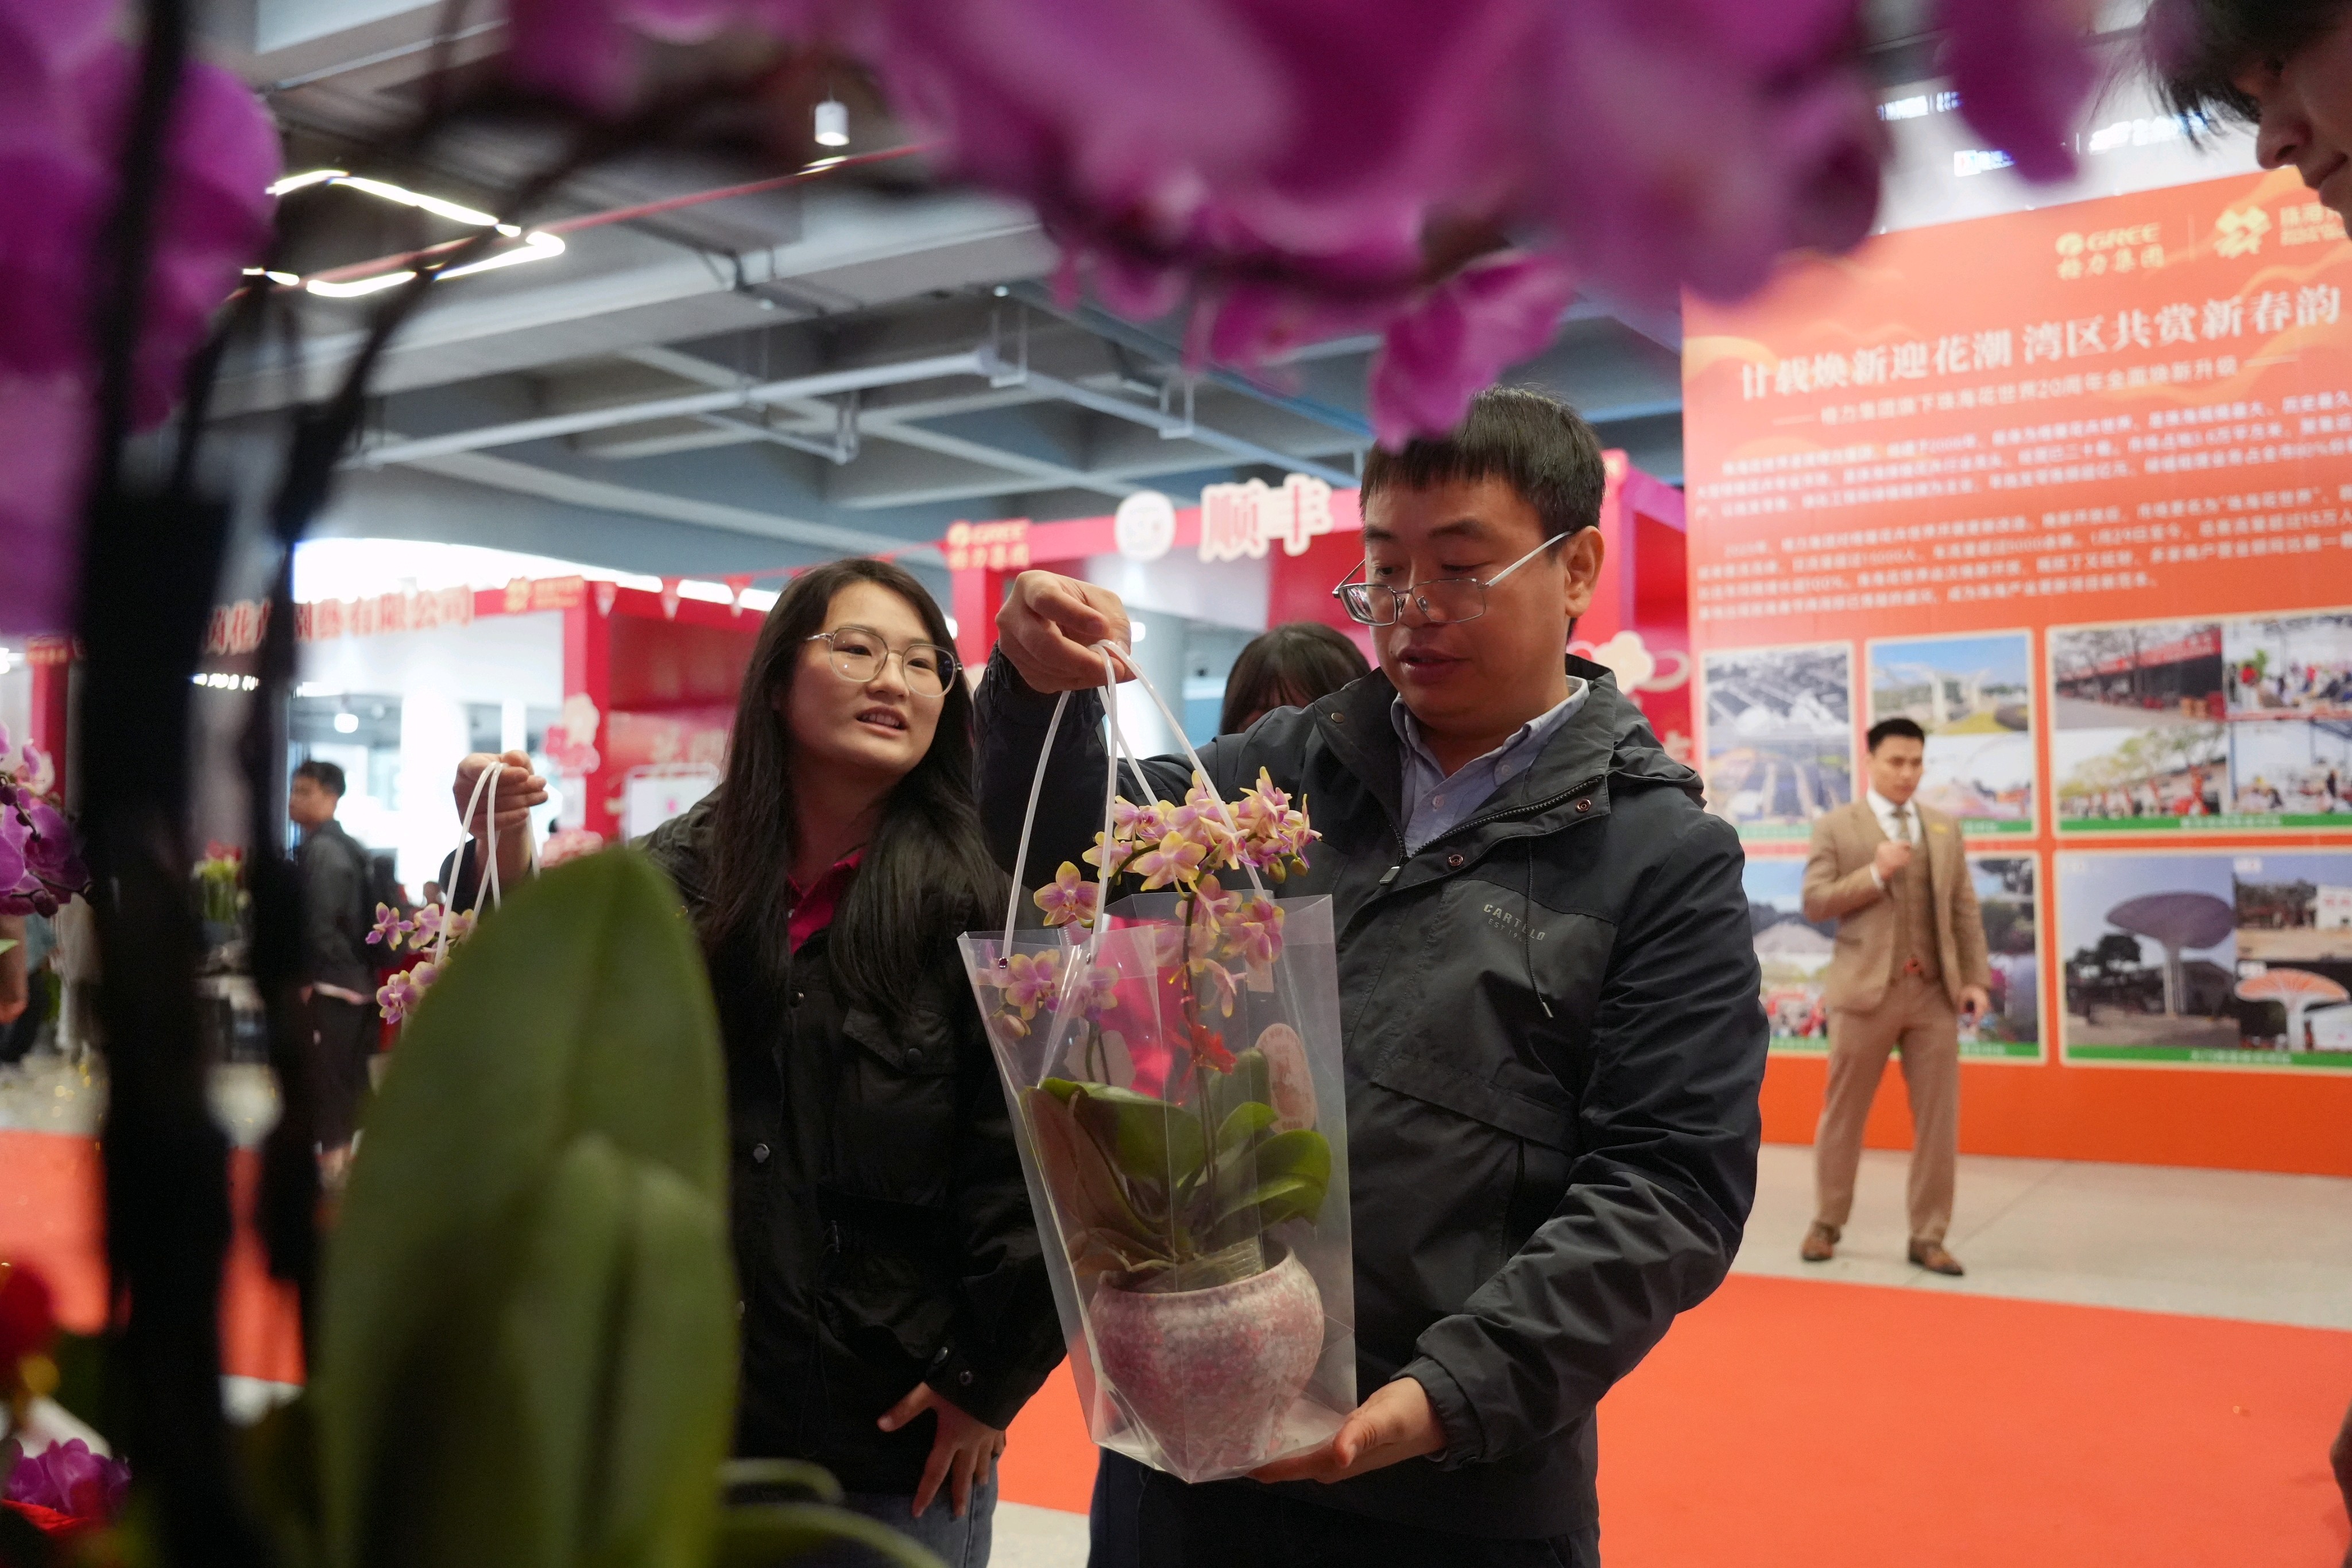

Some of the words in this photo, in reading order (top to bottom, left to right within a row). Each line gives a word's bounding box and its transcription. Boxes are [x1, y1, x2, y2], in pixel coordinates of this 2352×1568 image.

[2087, 222, 2161, 251] GREE
[2057, 243, 2164, 281] 格力集团
[1742, 329, 2013, 400] 廿载焕新迎花潮
[2023, 284, 2341, 363] 湾区共赏新春韵
[1201, 477, 1332, 562] 顺丰
[1488, 918, 1505, 931] EST
